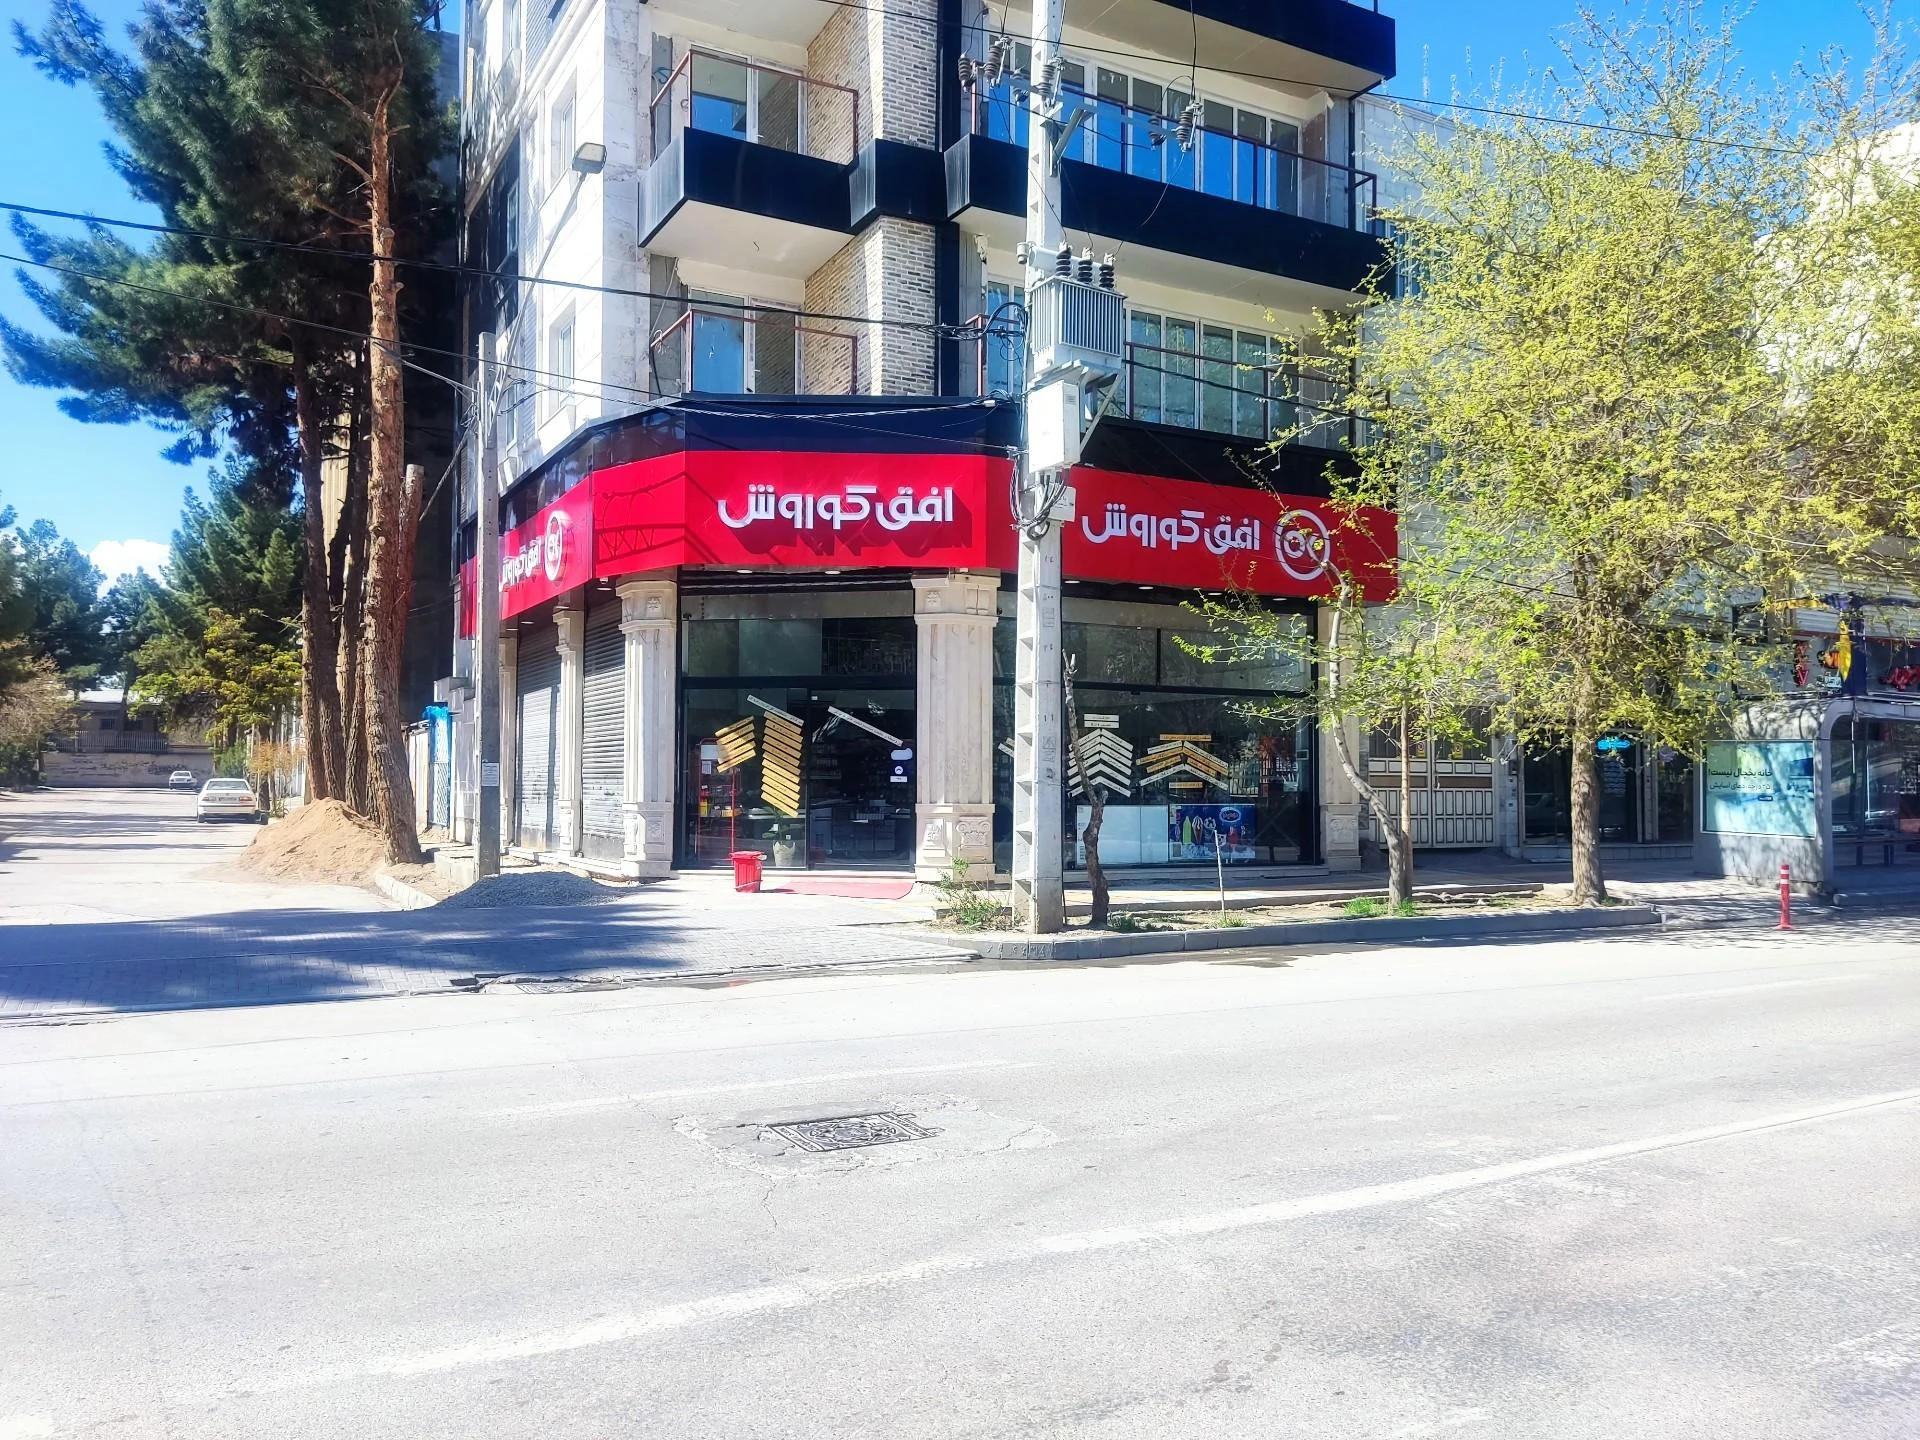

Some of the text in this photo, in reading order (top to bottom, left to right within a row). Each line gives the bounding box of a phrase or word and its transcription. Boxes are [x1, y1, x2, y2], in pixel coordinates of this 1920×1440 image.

[717, 484, 953, 531] افق کوروش
[1082, 503, 1260, 555] افق کوروش
[1733, 767, 1757, 779] یخچال
[1757, 768, 1773, 777] خانه
